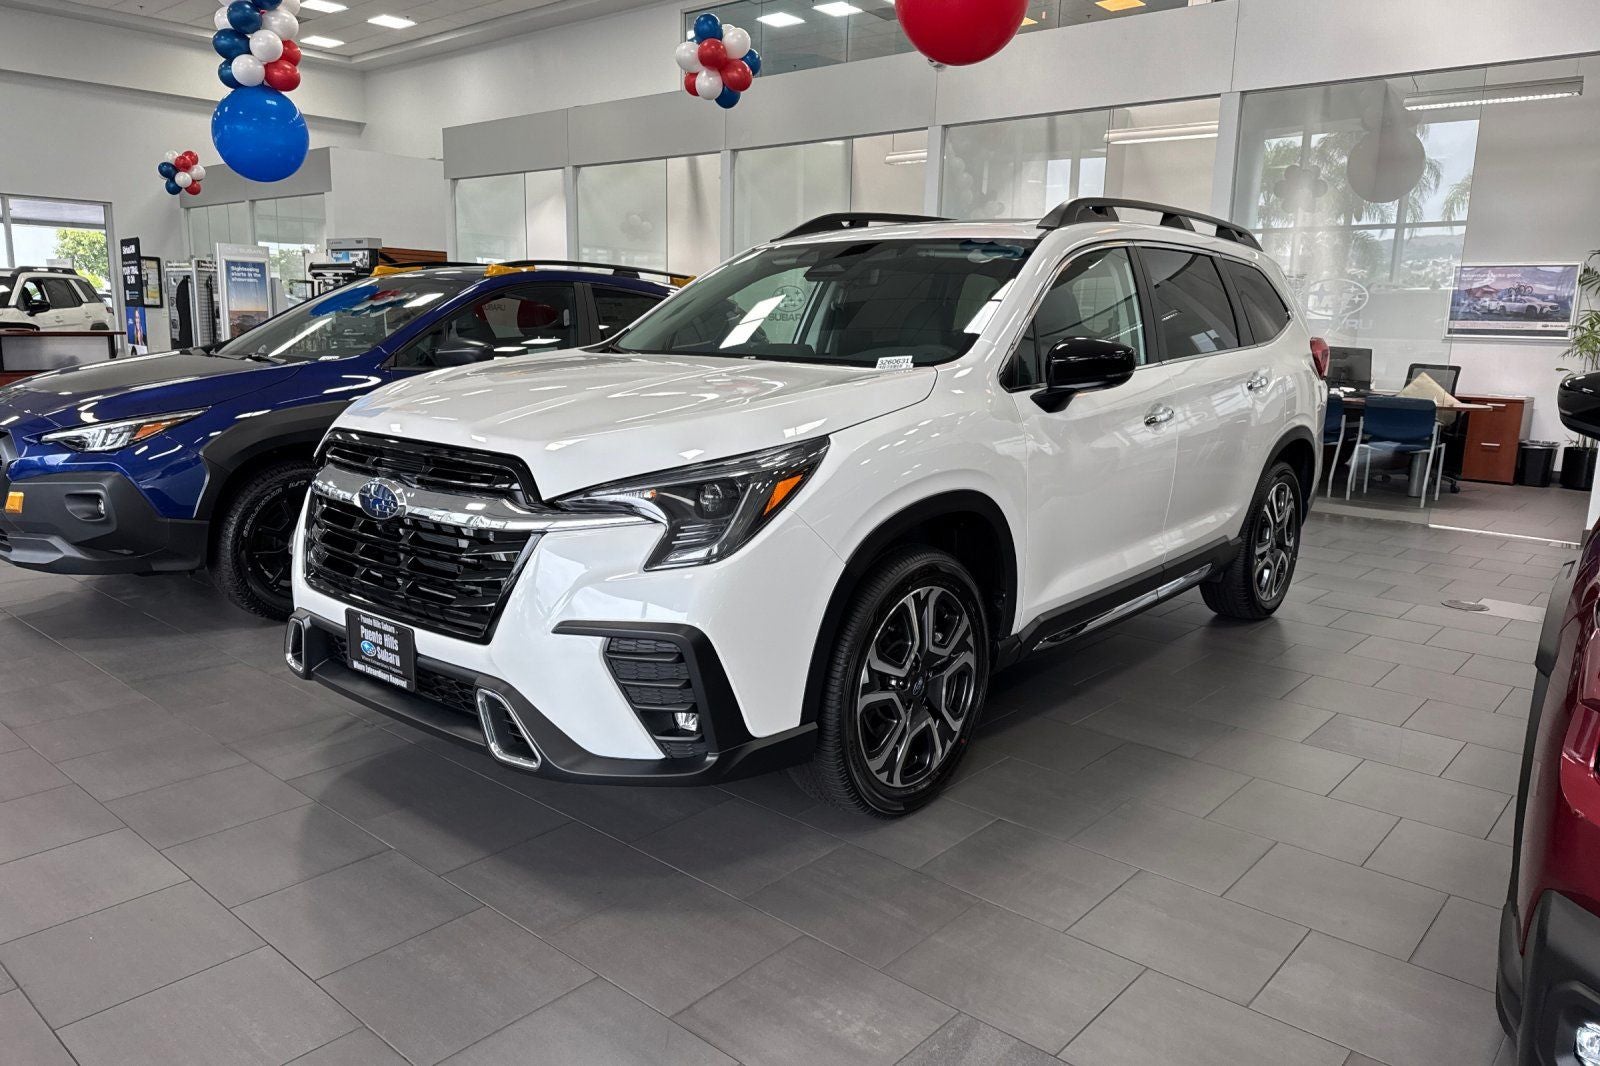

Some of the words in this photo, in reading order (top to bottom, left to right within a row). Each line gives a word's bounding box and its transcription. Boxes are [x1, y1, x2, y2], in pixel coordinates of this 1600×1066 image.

[360, 625, 383, 645] Puente
[383, 633, 399, 651] Hills
[376, 646, 400, 667] Subaru
